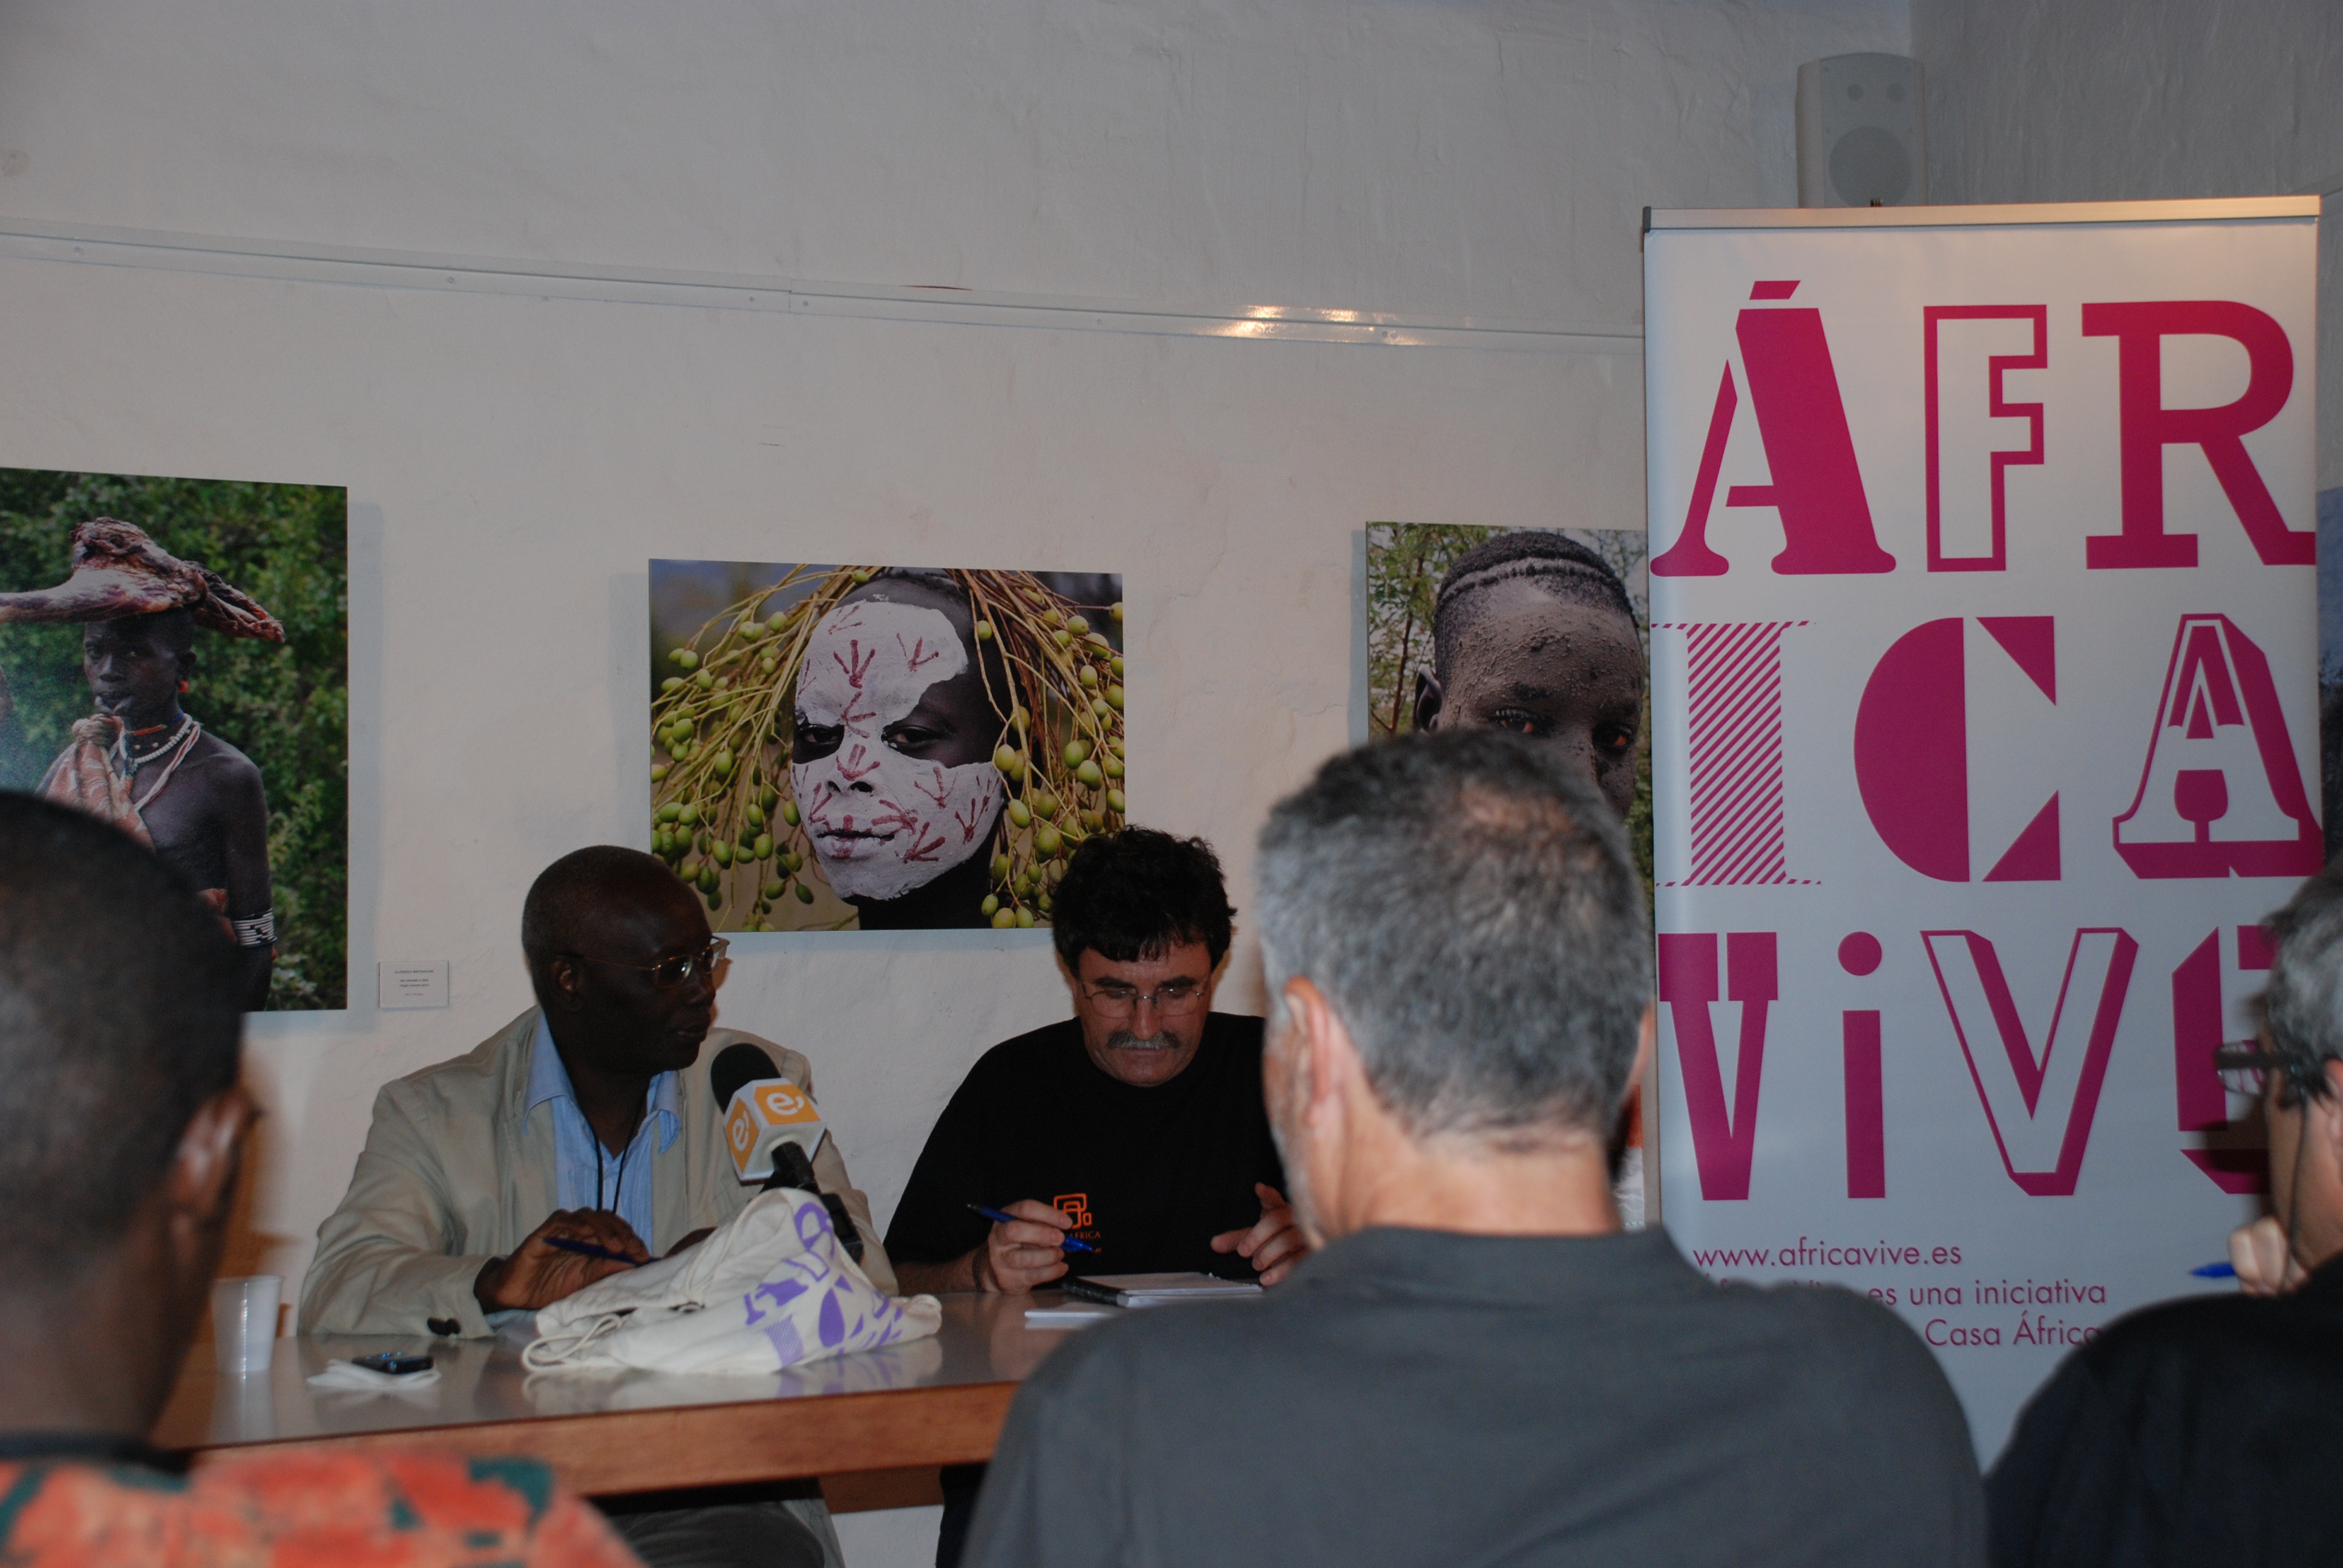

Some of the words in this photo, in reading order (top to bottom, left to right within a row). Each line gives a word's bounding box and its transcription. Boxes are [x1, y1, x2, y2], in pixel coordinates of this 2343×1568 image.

[1693, 1236, 1962, 1267] www.africavive.es
[1909, 1287, 1962, 1305] una
[1974, 1279, 2106, 1305] iniciativa
[1925, 1318, 2001, 1347] Casa
